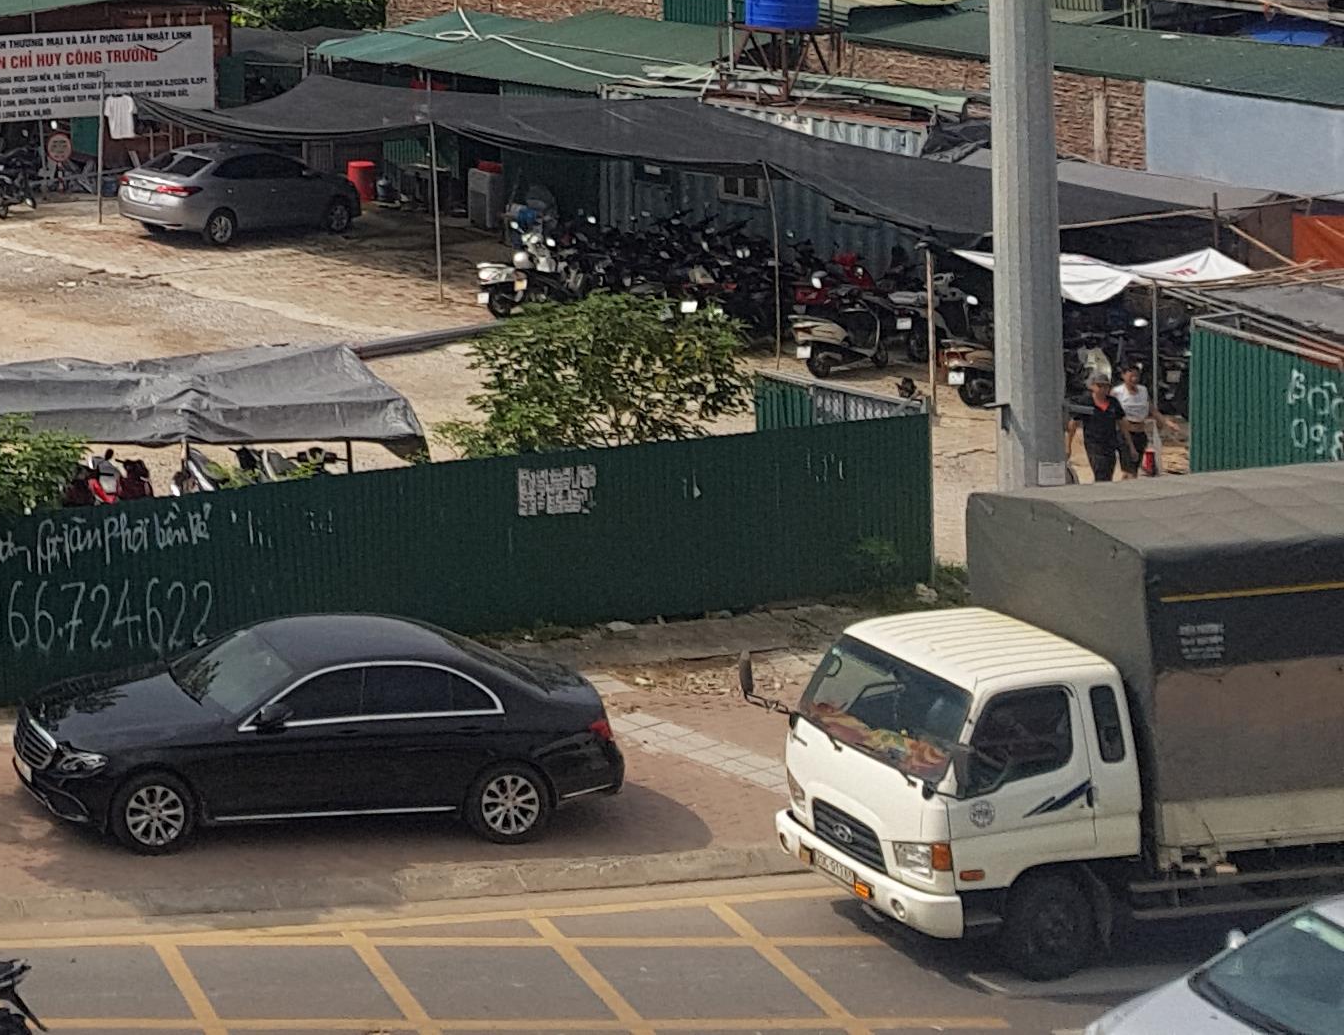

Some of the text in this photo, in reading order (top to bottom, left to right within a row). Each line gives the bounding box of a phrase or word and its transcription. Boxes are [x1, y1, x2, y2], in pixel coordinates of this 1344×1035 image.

[10, 50, 32, 69] CHỈ
[36, 52, 62, 67] HUY
[66, 49, 102, 65] CÔNG
[106, 46, 158, 63] TRƯỜNG
